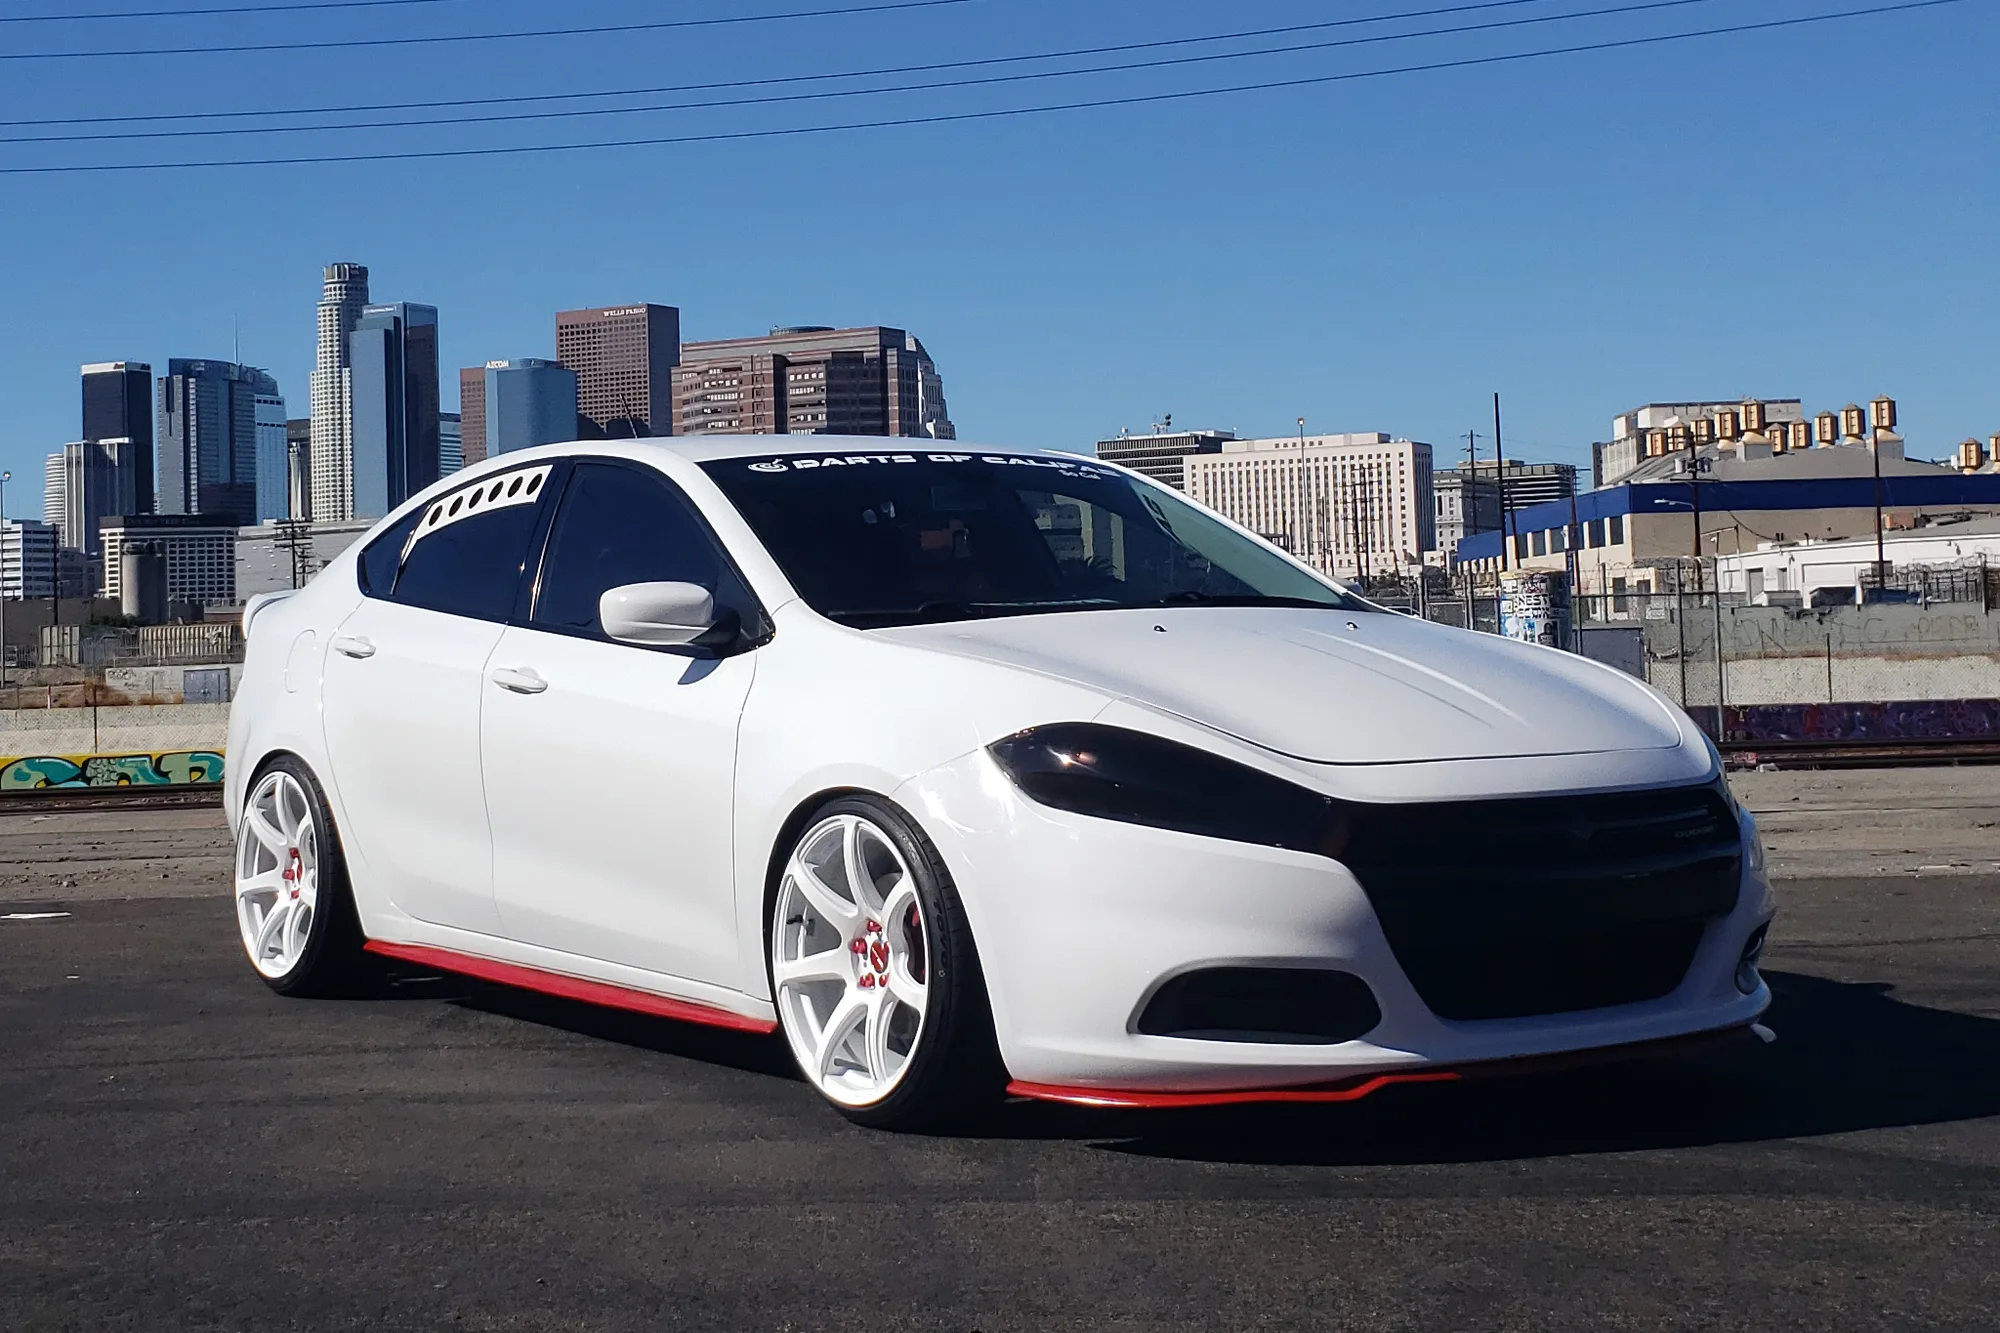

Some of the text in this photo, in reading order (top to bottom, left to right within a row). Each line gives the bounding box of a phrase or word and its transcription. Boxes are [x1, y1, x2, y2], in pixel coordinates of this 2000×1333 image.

[485, 359, 510, 369] AECOM
[791, 454, 1122, 478] DARTS OF CALIFAS
